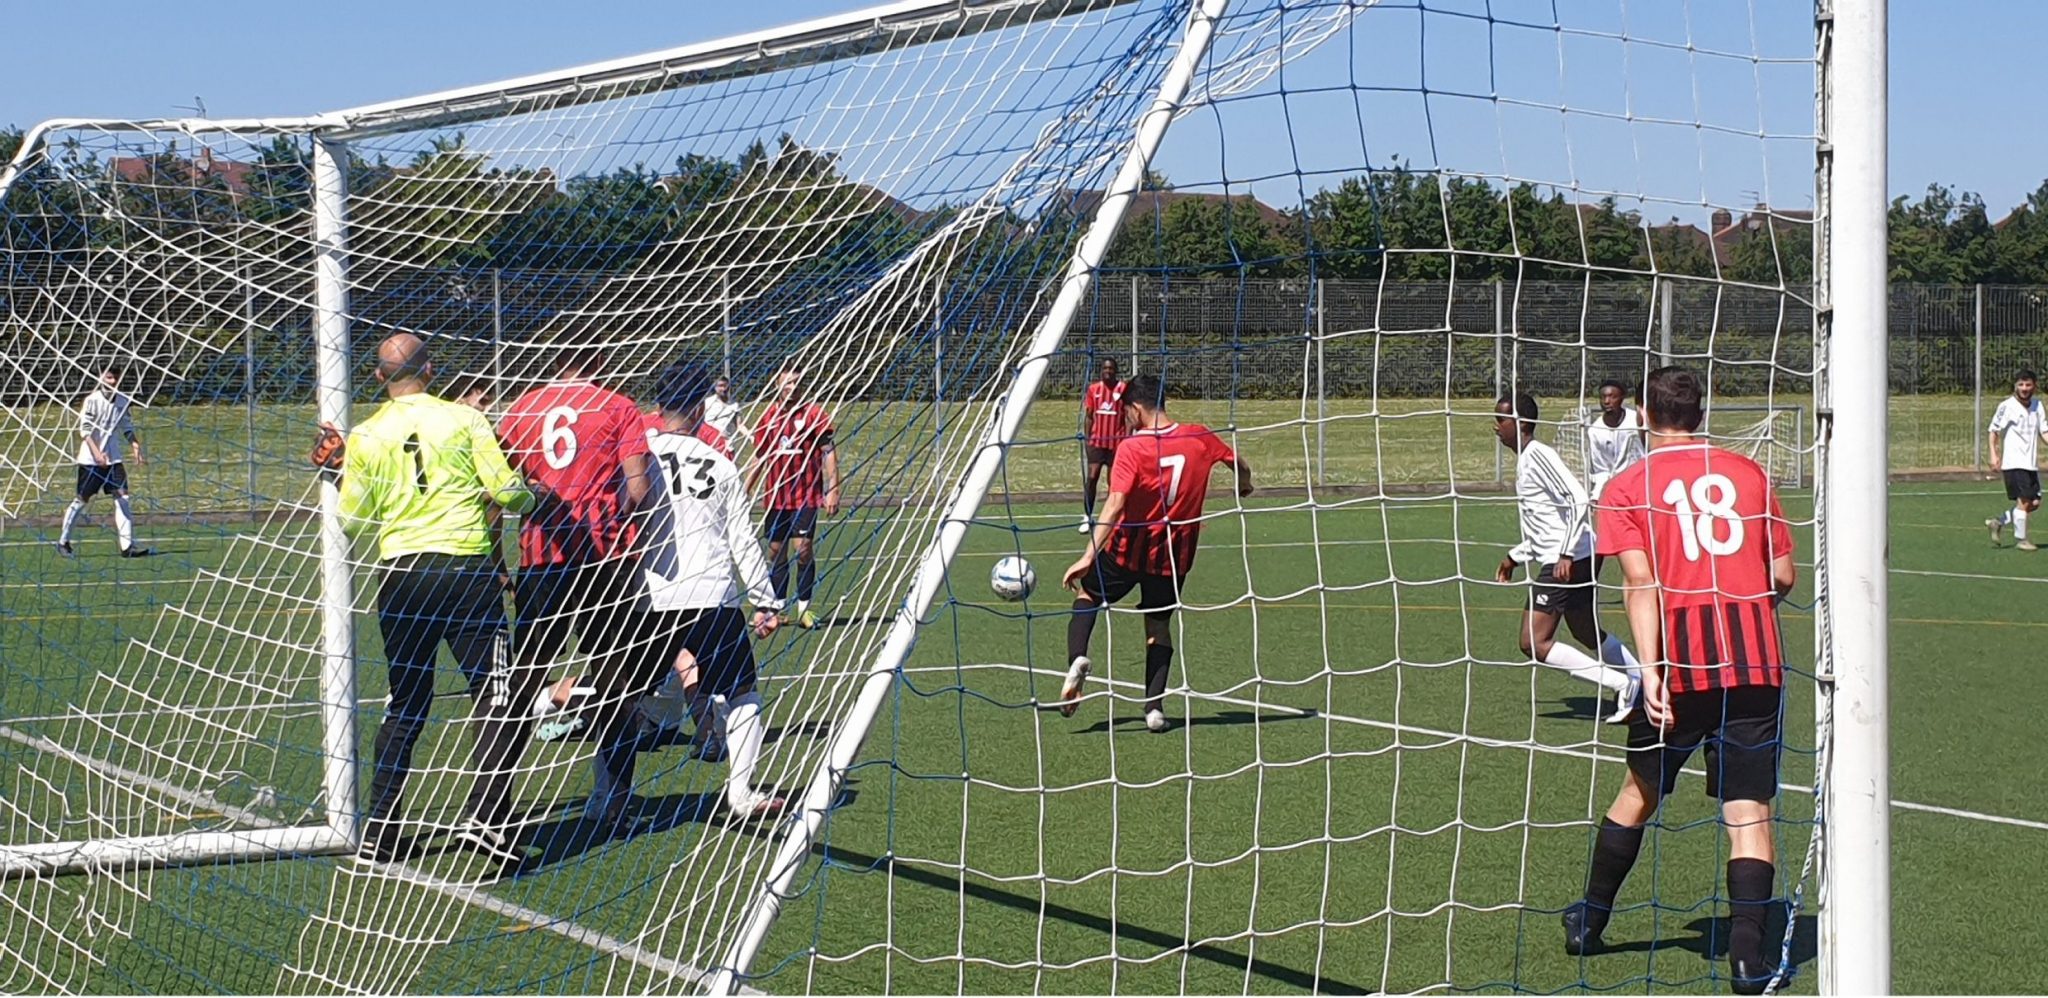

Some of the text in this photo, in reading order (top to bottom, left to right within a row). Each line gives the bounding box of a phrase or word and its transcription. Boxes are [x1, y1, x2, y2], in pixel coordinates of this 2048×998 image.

[403, 432, 429, 494] 1
[541, 405, 579, 470] 6
[659, 452, 716, 500] 13
[1159, 453, 1185, 507] 7
[1662, 473, 1745, 562] 18
